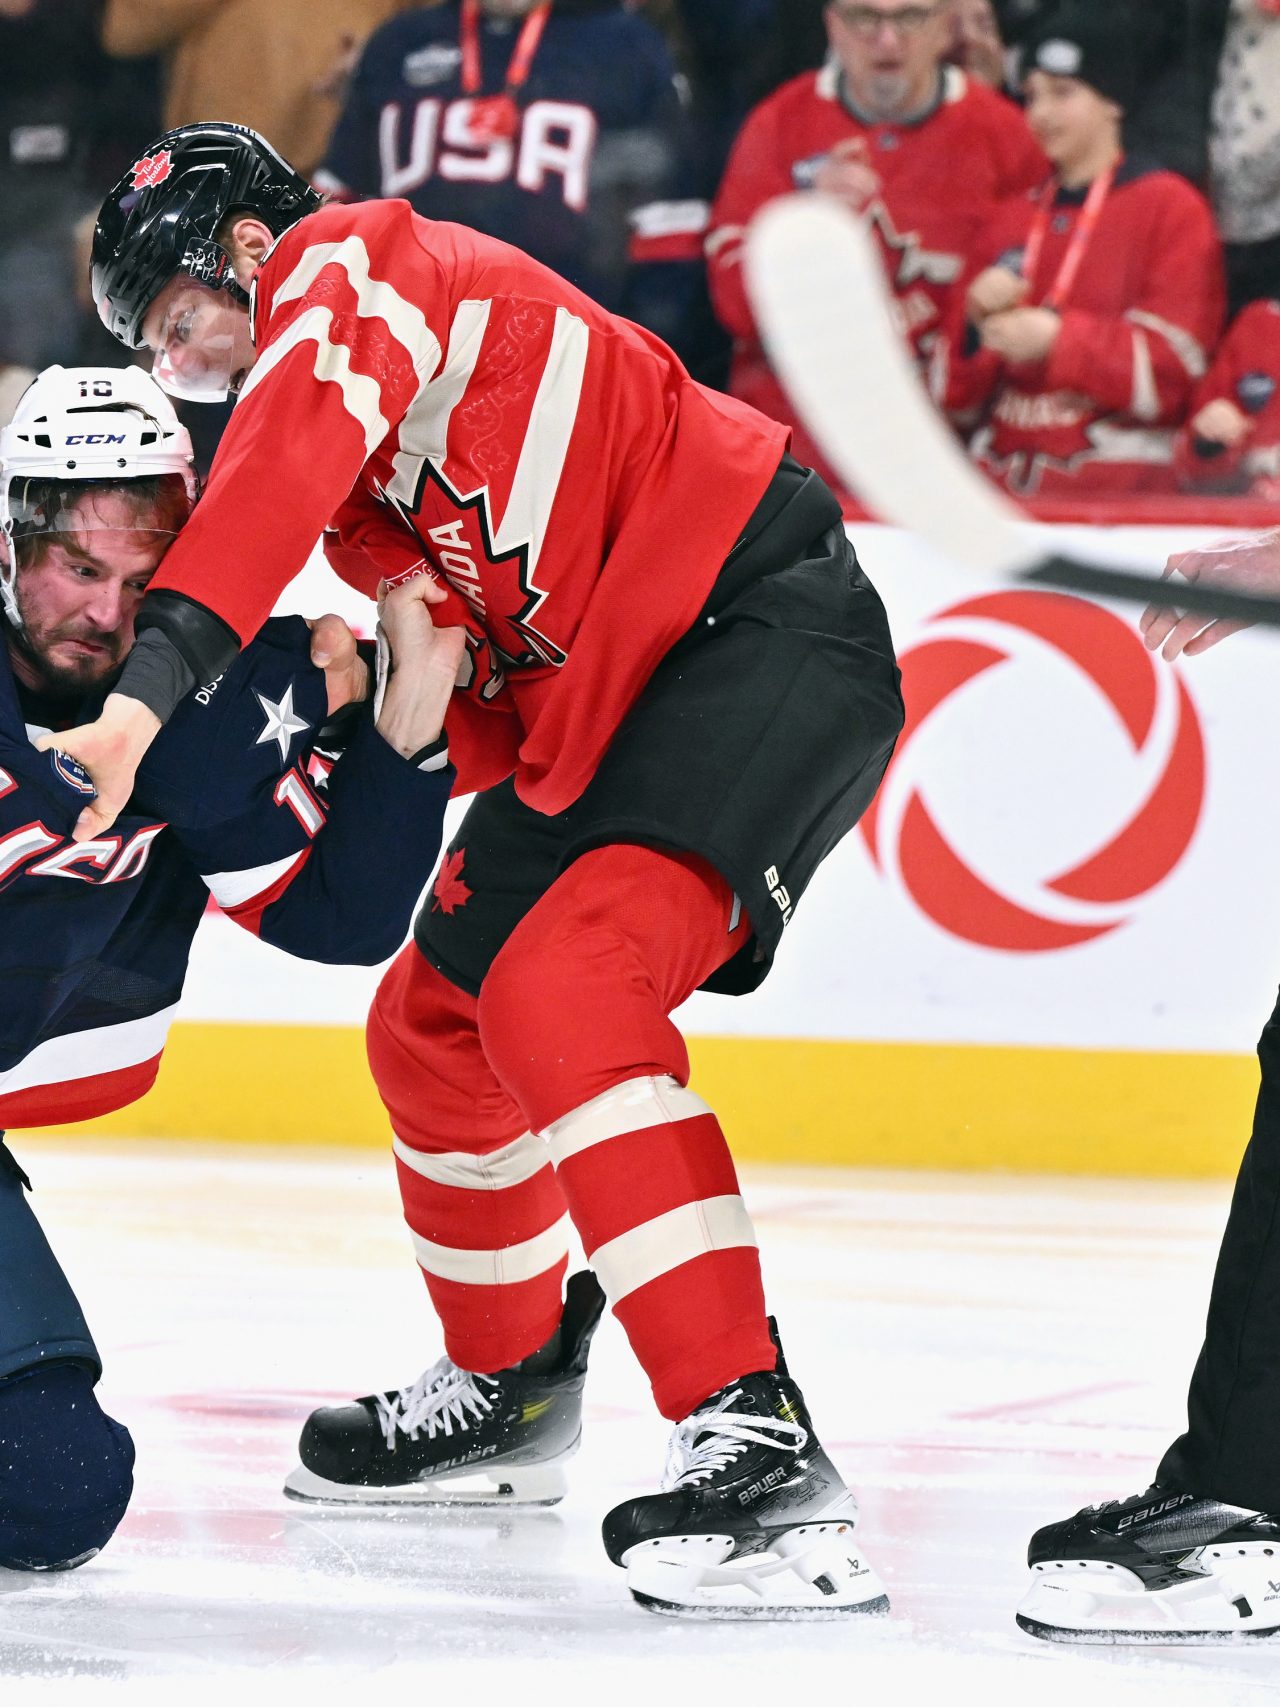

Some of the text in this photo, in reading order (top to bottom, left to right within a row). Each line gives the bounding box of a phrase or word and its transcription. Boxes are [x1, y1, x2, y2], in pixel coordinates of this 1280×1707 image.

[378, 98, 598, 213] USA
[77, 380, 113, 397] 10
[65, 434, 127, 446] CCM
